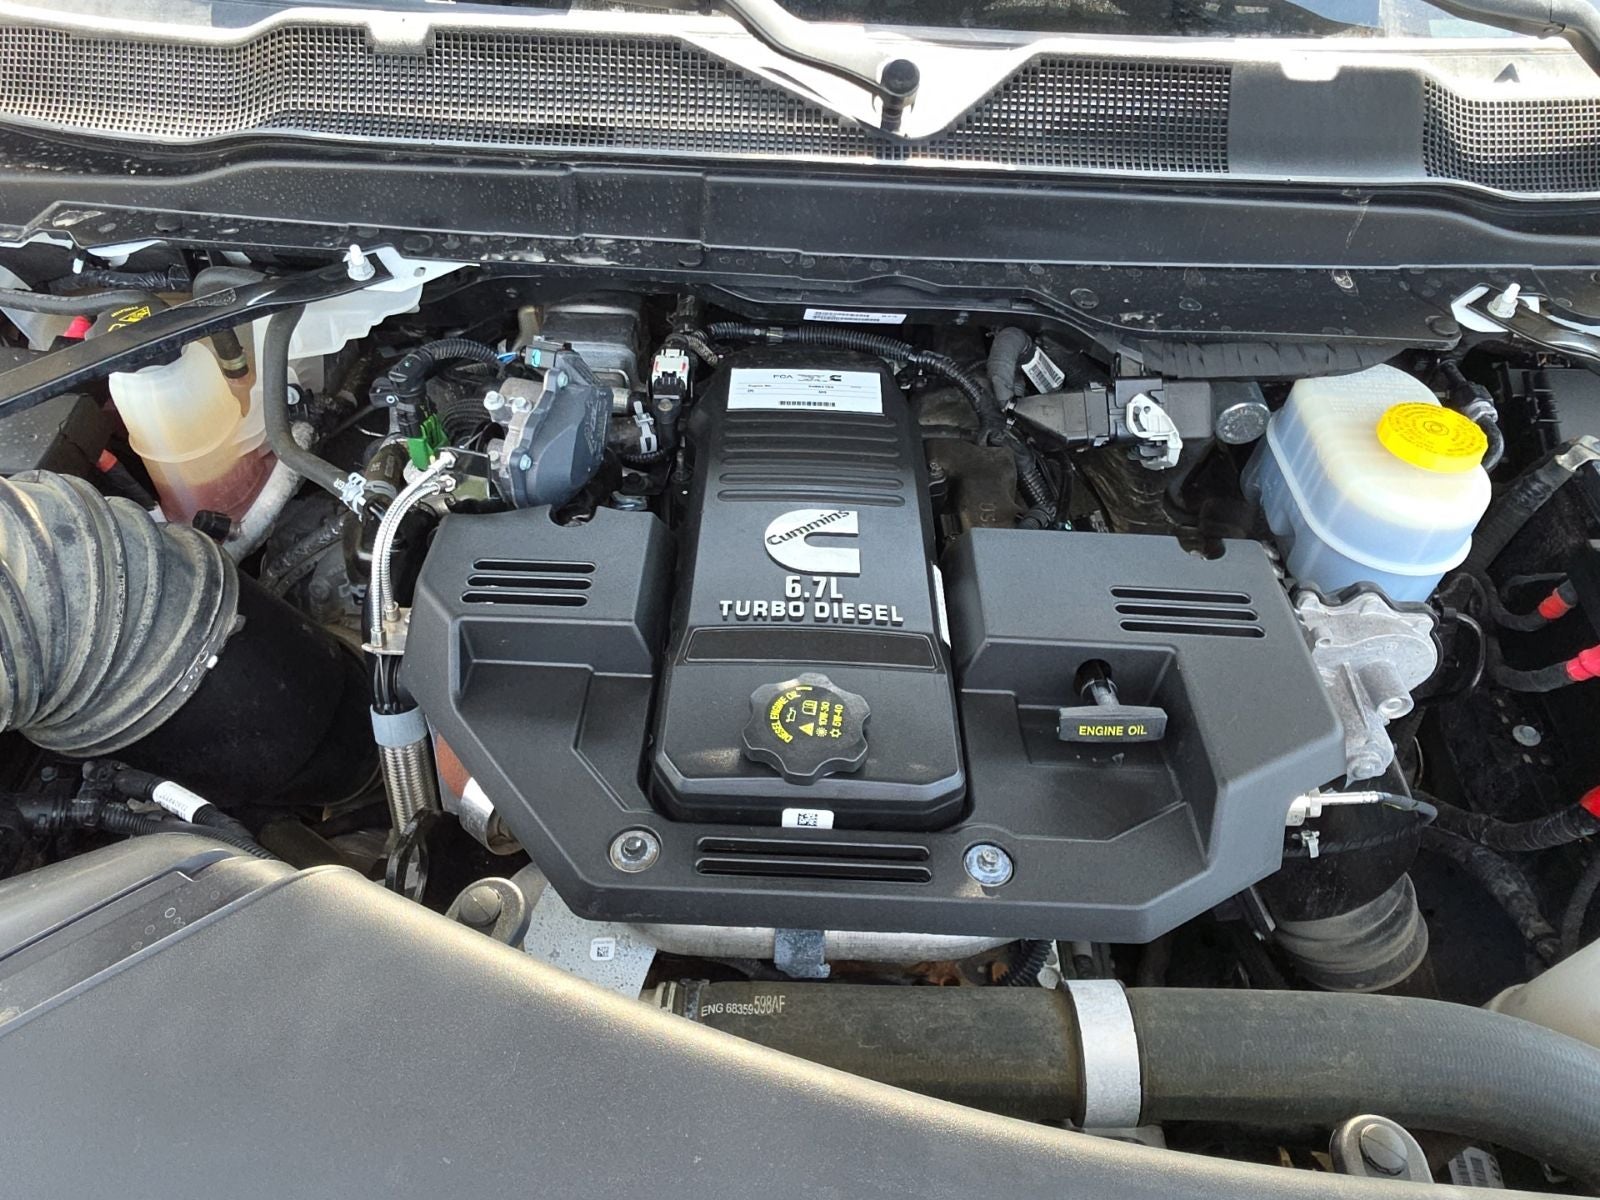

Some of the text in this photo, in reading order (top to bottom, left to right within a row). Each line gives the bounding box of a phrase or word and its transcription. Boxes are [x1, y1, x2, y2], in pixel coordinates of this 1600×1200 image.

[766, 509, 850, 546] Cummins
[785, 575, 844, 600] 6.7L
[719, 600, 904, 625] TURBO DIESEL
[1078, 724, 1148, 736] ENGINE OIL
[701, 1003, 724, 1017] ENG
